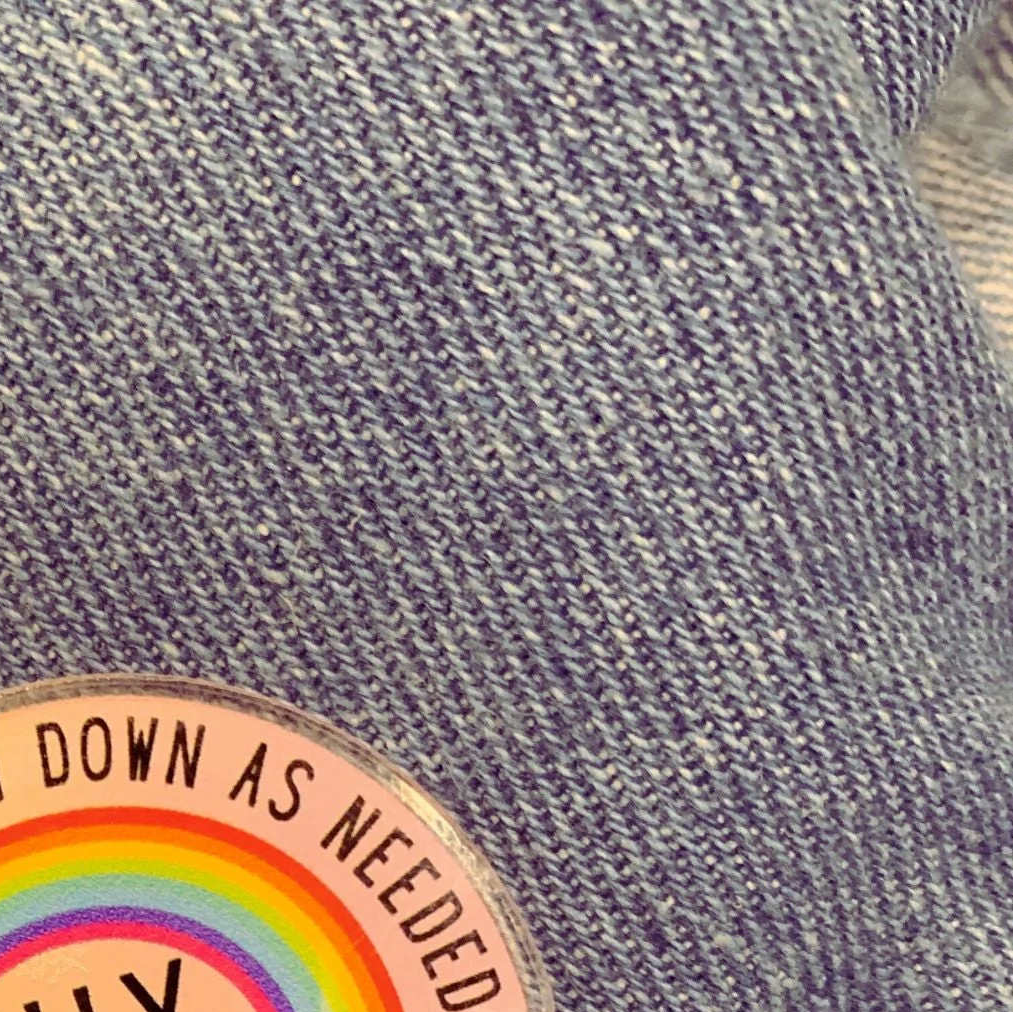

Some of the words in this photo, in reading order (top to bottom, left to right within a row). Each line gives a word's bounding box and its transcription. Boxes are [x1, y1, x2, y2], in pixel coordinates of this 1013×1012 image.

[36, 717, 205, 789] DOWN
[229, 742, 314, 821] AS
[321, 795, 501, 1012] NEEDED
